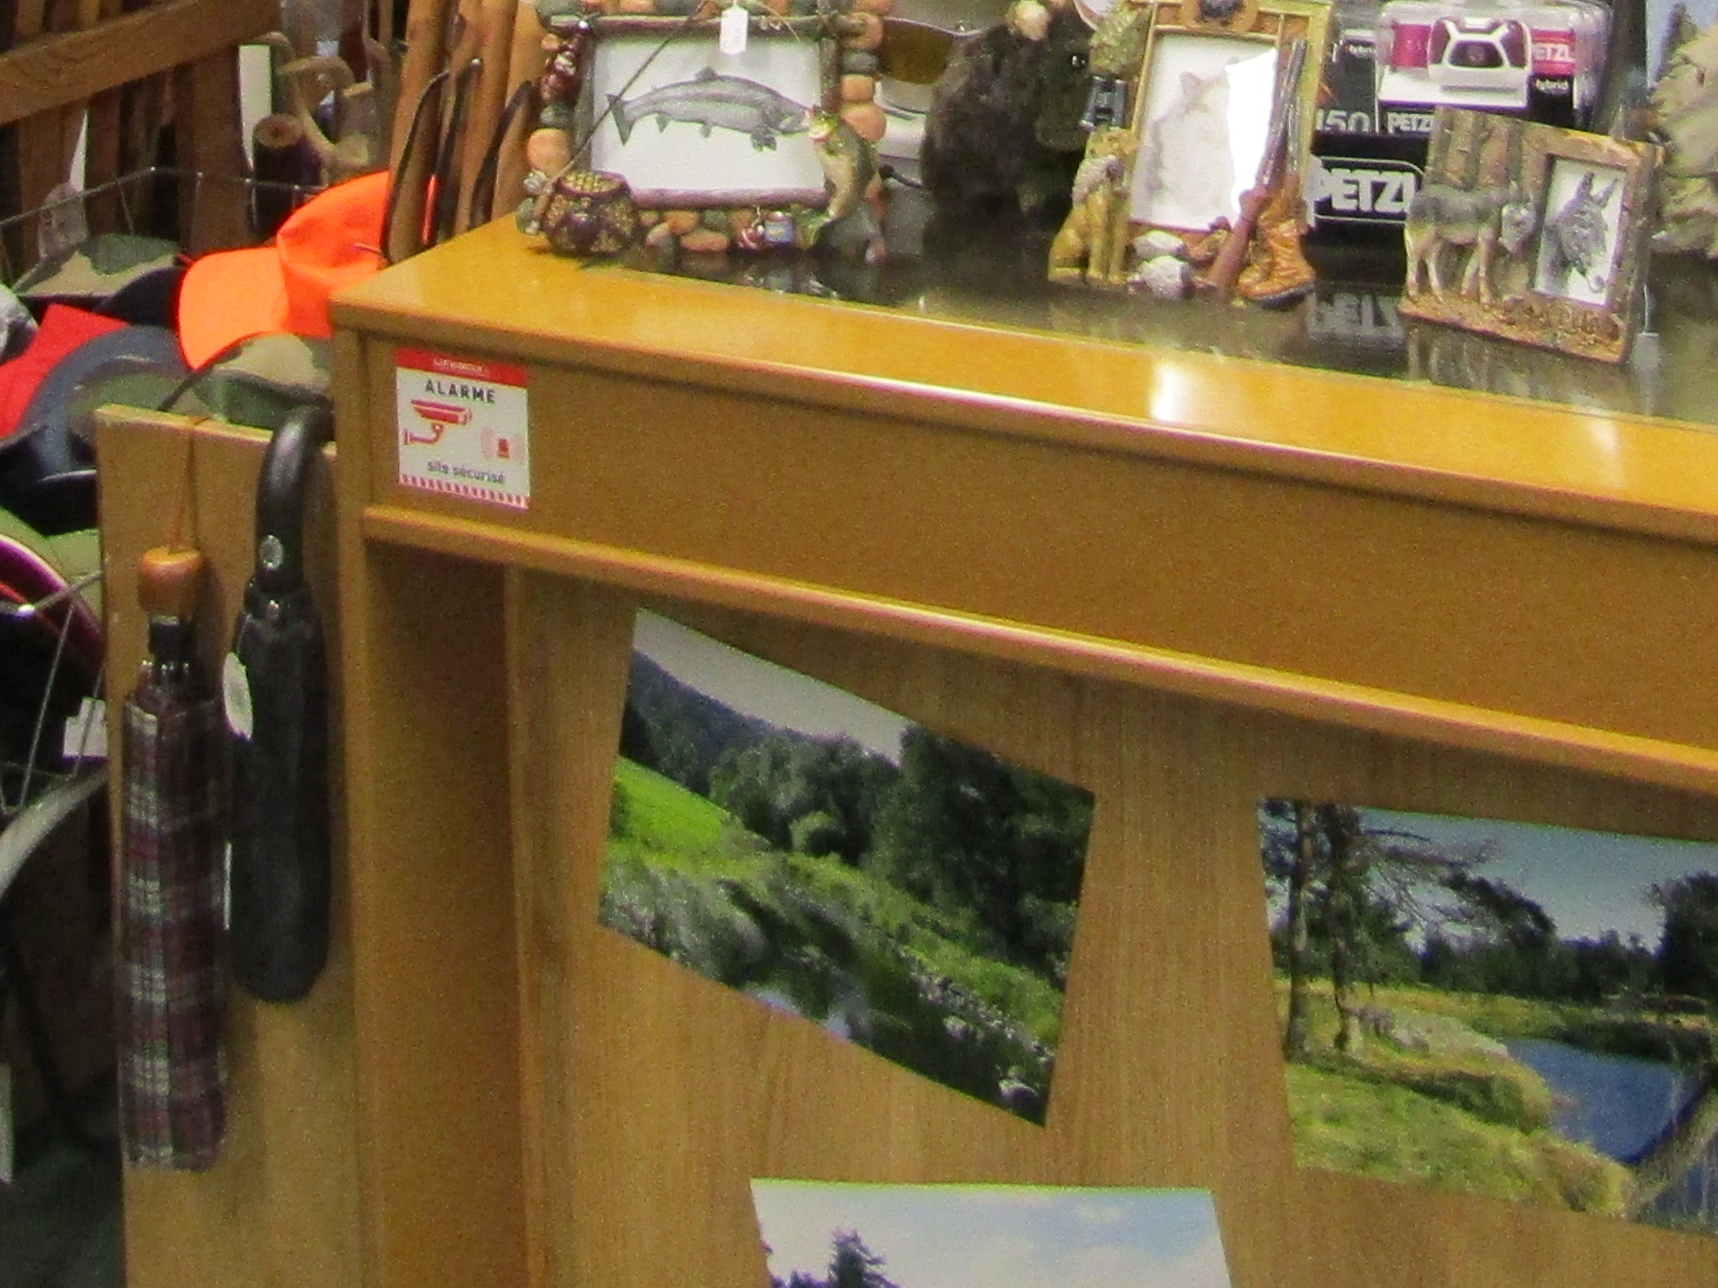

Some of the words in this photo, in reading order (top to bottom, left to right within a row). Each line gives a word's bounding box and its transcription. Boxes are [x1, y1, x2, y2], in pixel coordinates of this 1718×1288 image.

[425, 378, 496, 404] ALARME
[428, 460, 450, 475] site
[453, 464, 506, 485] sécurisé
